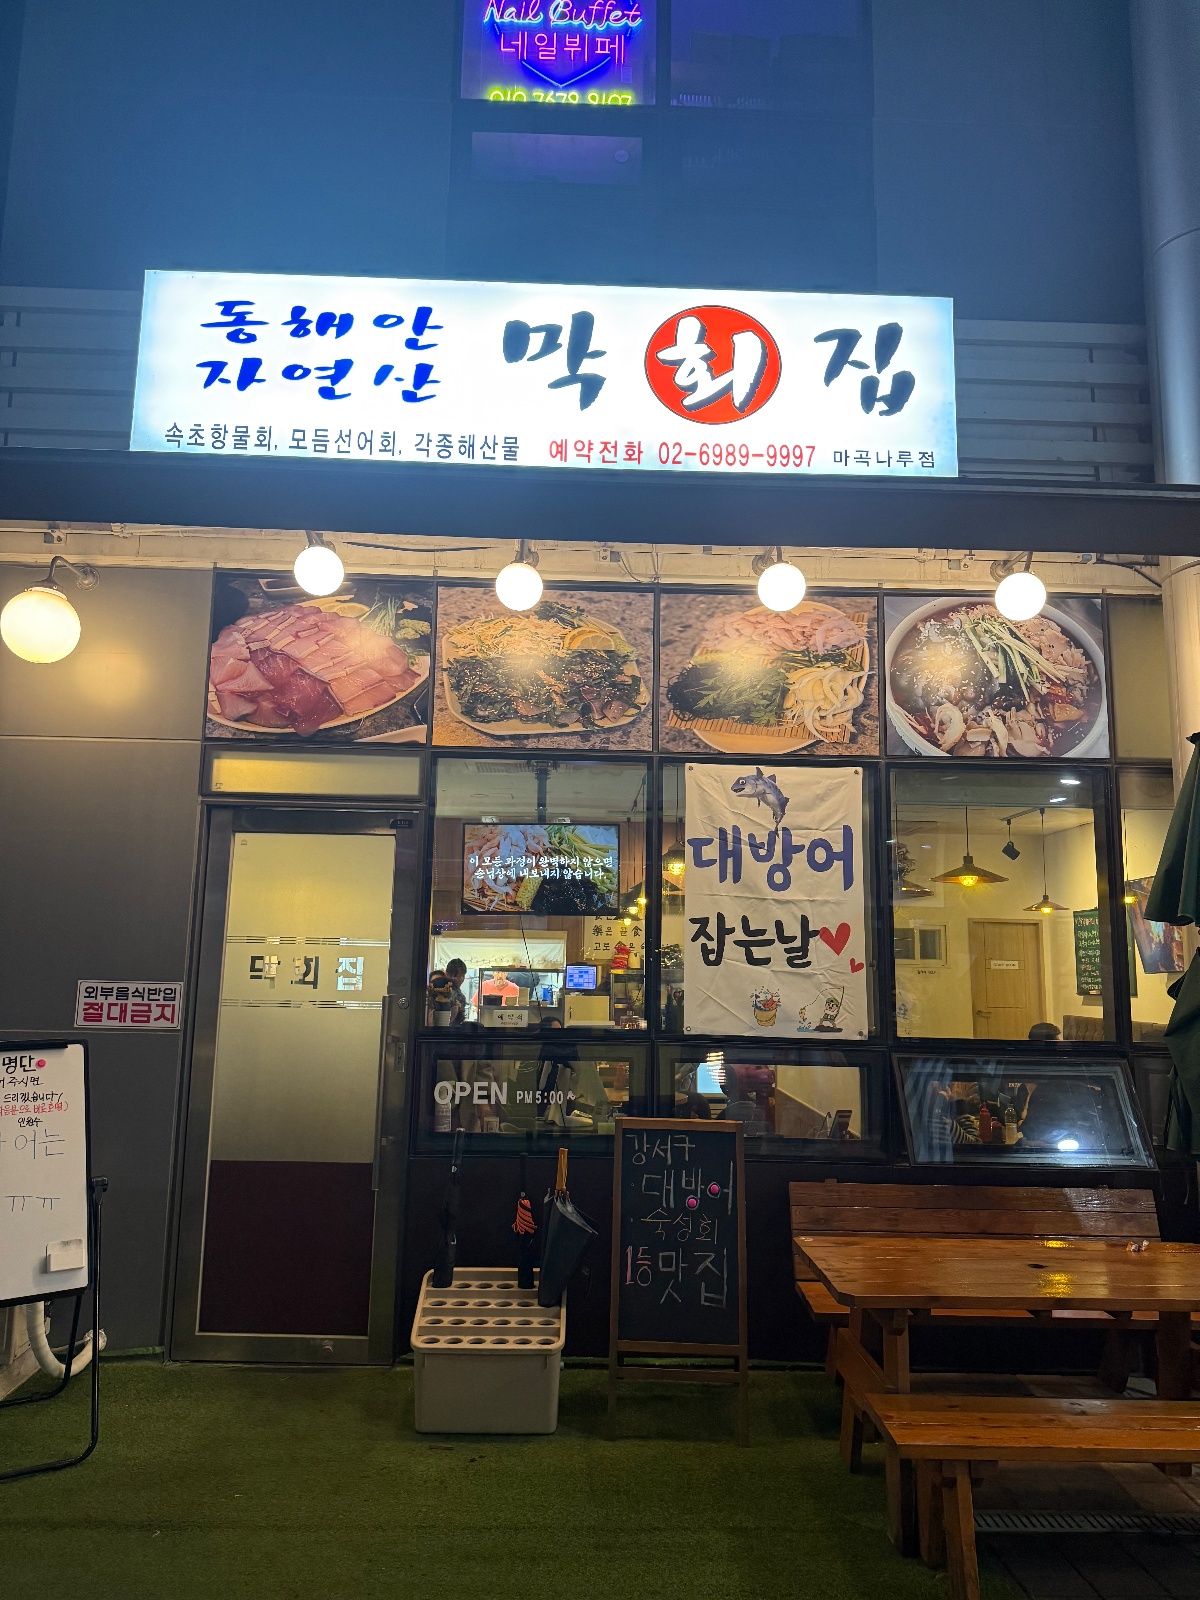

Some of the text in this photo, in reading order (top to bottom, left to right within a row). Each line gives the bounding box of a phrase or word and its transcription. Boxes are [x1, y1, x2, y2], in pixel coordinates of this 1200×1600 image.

[484, 0, 642, 30] Nail Buffet
[500, 31, 625, 64] 네일뷔페
[200, 299, 444, 351] 동해안
[196, 356, 441, 403] 자연산
[164, 422, 935, 468] 속초항물회, 모듬선어회, 각종해산물 예약전화 02-6989-9997 마곡나루점
[469, 855, 613, 869] 이 모든 과정이 완벽하지 않으면
[474, 868, 607, 880] 손님상에 내보내지 않습니다.
[687, 824, 854, 892] 대방어
[688, 911, 820, 969] 잡는날
[83, 986, 177, 1002] 외부음식반입
[82, 1001, 177, 1025] 절대금지
[2, 1055, 37, 1075] 명단
[7, 1076, 44, 1088] 주시면
[433, 1080, 508, 1105] OPEN
[516, 1090, 533, 1104] PM
[625, 1132, 696, 1165] 강서구
[641, 1160, 733, 1215] 대방어
[640, 1207, 718, 1245] 숙성회
[625, 1245, 728, 1309] 1등 맛집
